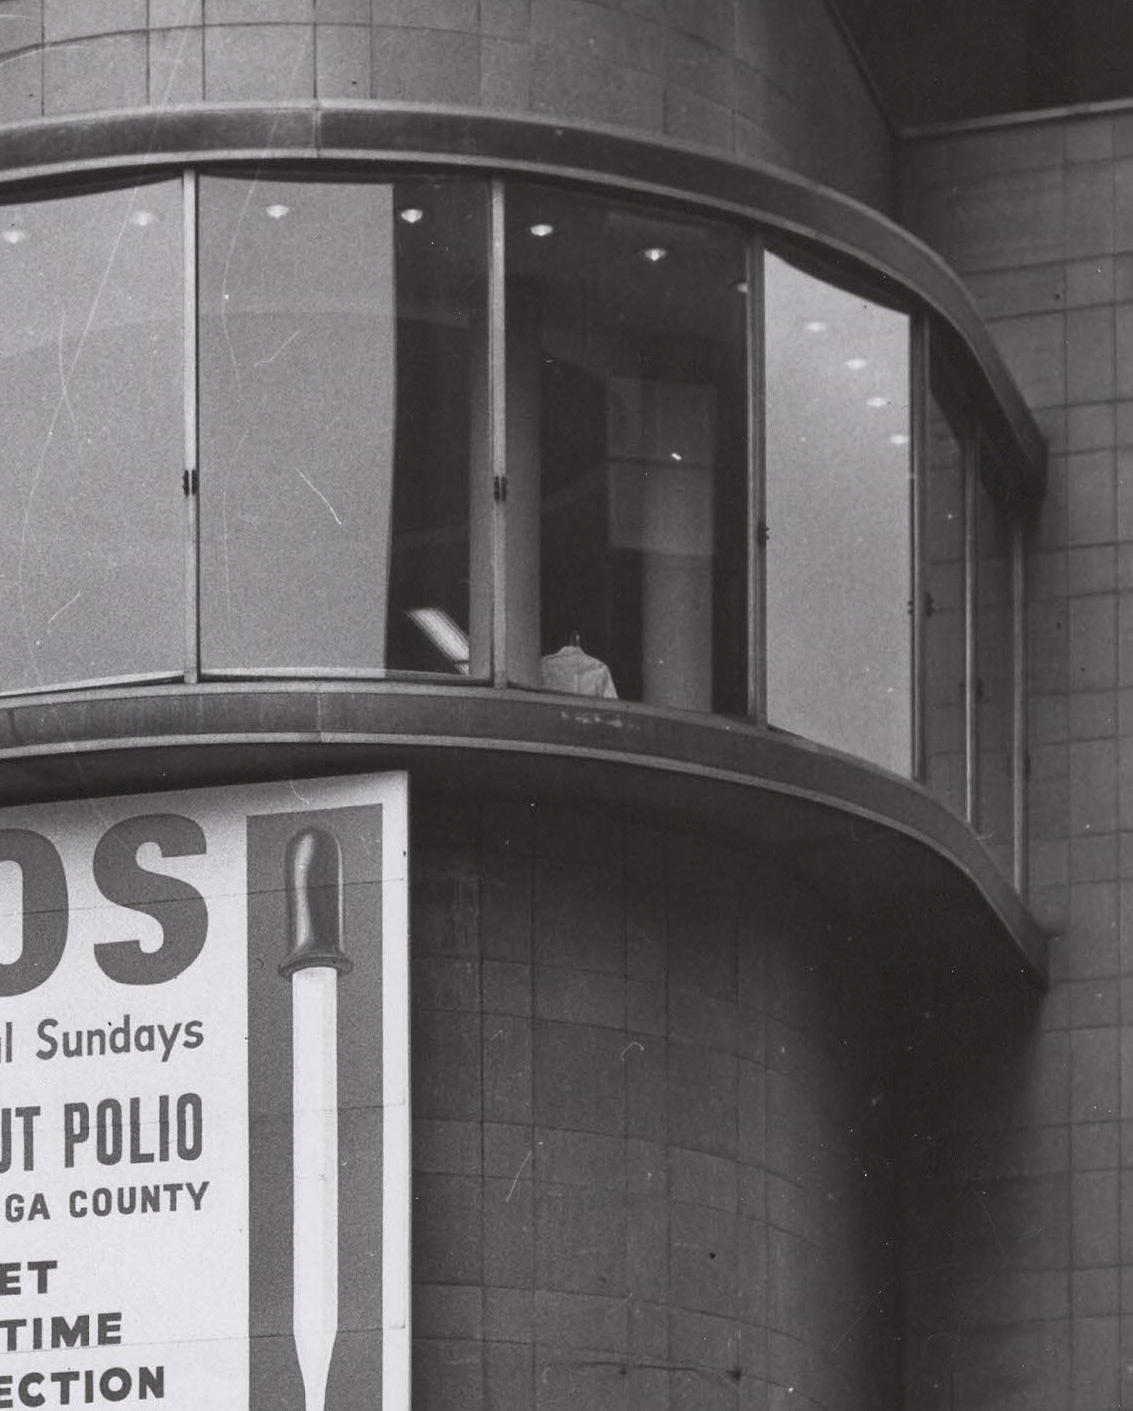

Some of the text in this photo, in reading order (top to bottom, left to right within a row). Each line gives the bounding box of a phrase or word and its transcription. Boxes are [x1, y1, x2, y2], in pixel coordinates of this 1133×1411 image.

[35, 1013, 204, 1063] Sundays
[63, 1092, 203, 1169] POLIO
[69, 1181, 210, 1218] COUNTY
